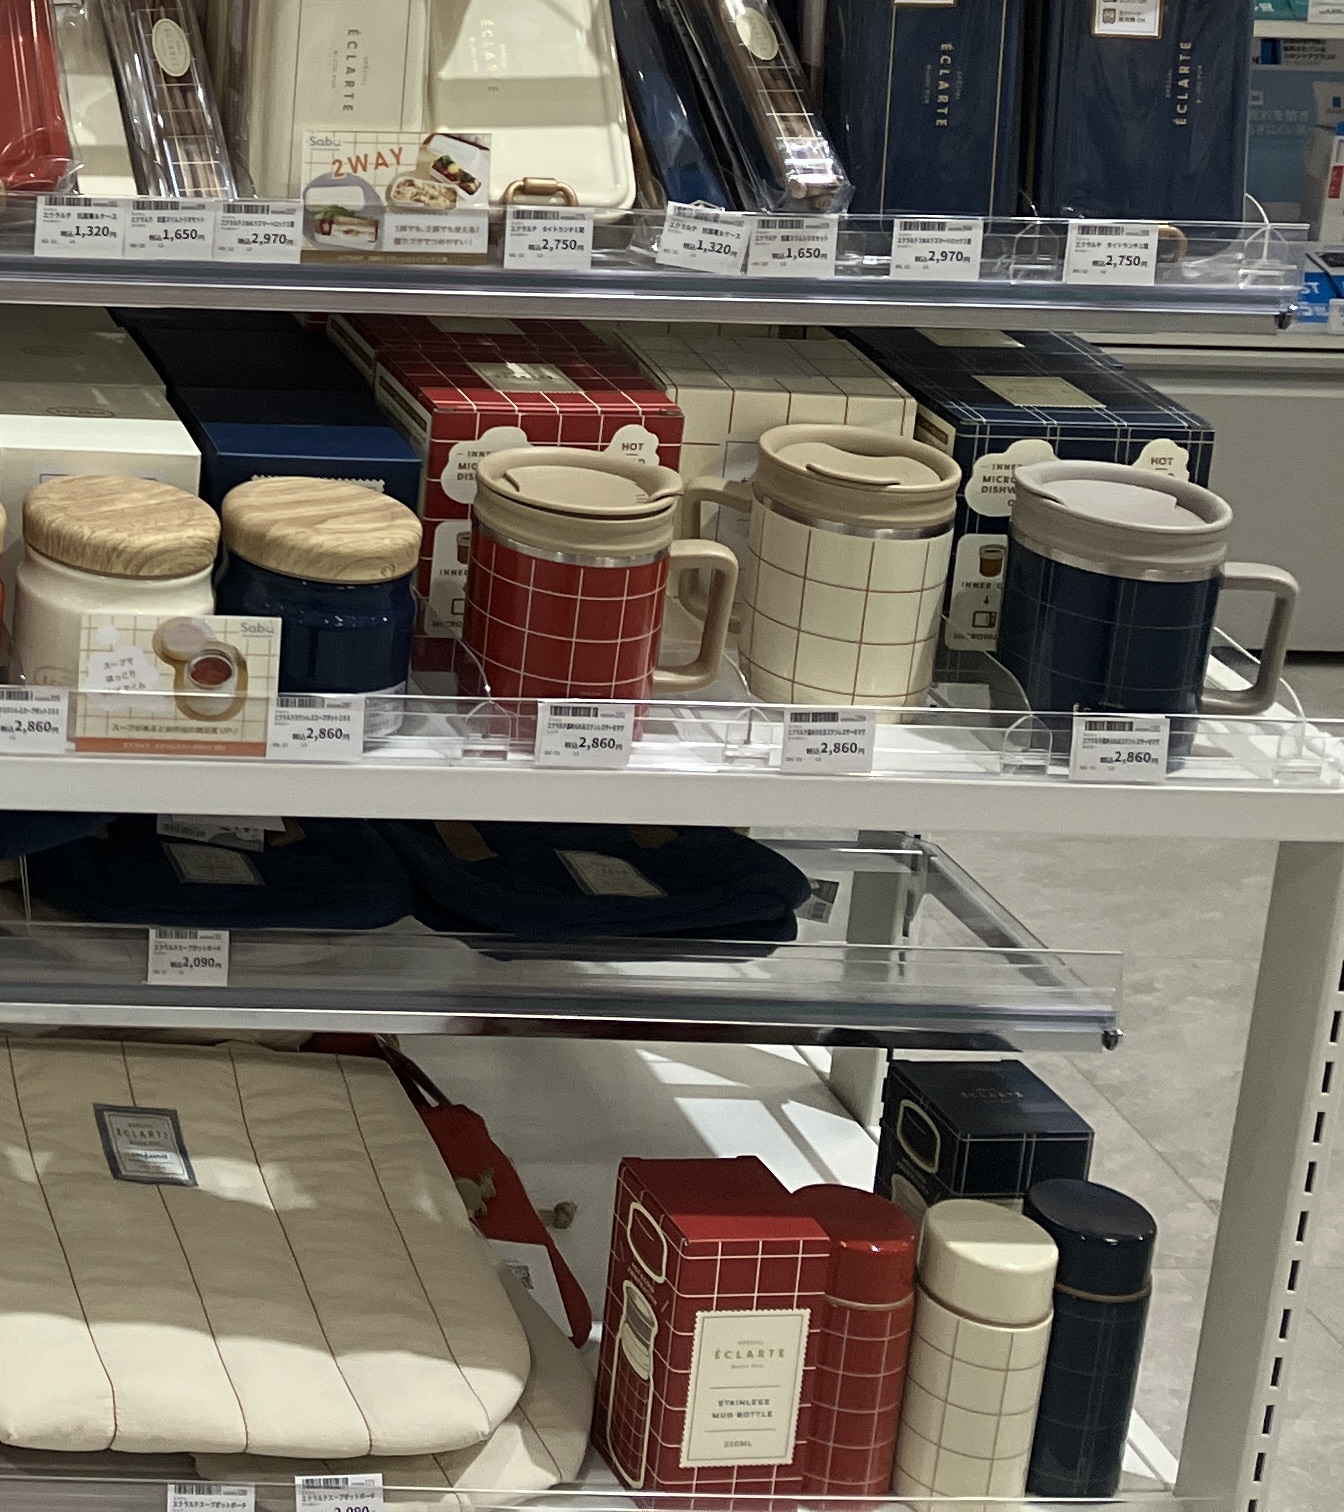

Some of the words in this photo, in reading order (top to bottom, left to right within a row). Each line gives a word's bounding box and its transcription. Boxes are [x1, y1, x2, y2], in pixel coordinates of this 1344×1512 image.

[342, 28, 360, 112] ÉCLARTE
[935, 42, 953, 127] ÉCLARTE
[1173, 41, 1192, 126] ÉCLARTE
[330, 146, 405, 180] 2WAY
[60, 223, 118, 239] 税込1,320円
[148, 227, 206, 242] 税込1,650円
[237, 231, 295, 248] 税込2,970円
[528, 236, 585, 253] 税込2,750円
[682, 237, 739, 259] 税込1,320円
[771, 246, 829, 262] 税込1,650円
[914, 249, 972, 265] 税込2,970円
[620, 441, 644, 452] HOT
[1150, 456, 1175, 467] HOT
[239, 622, 277, 635] Sabu
[0, 719, 60, 736] 税込2,860円
[291, 725, 351, 744] 税込2,860円
[564, 735, 624, 754] 税込2,860円
[806, 740, 866, 758] 税込2,860円
[169, 954, 223, 970] 税込2,090円
[714, 1347, 786, 1360] ÉCLARTE
[717, 1398, 771, 1407] STAINLESS
